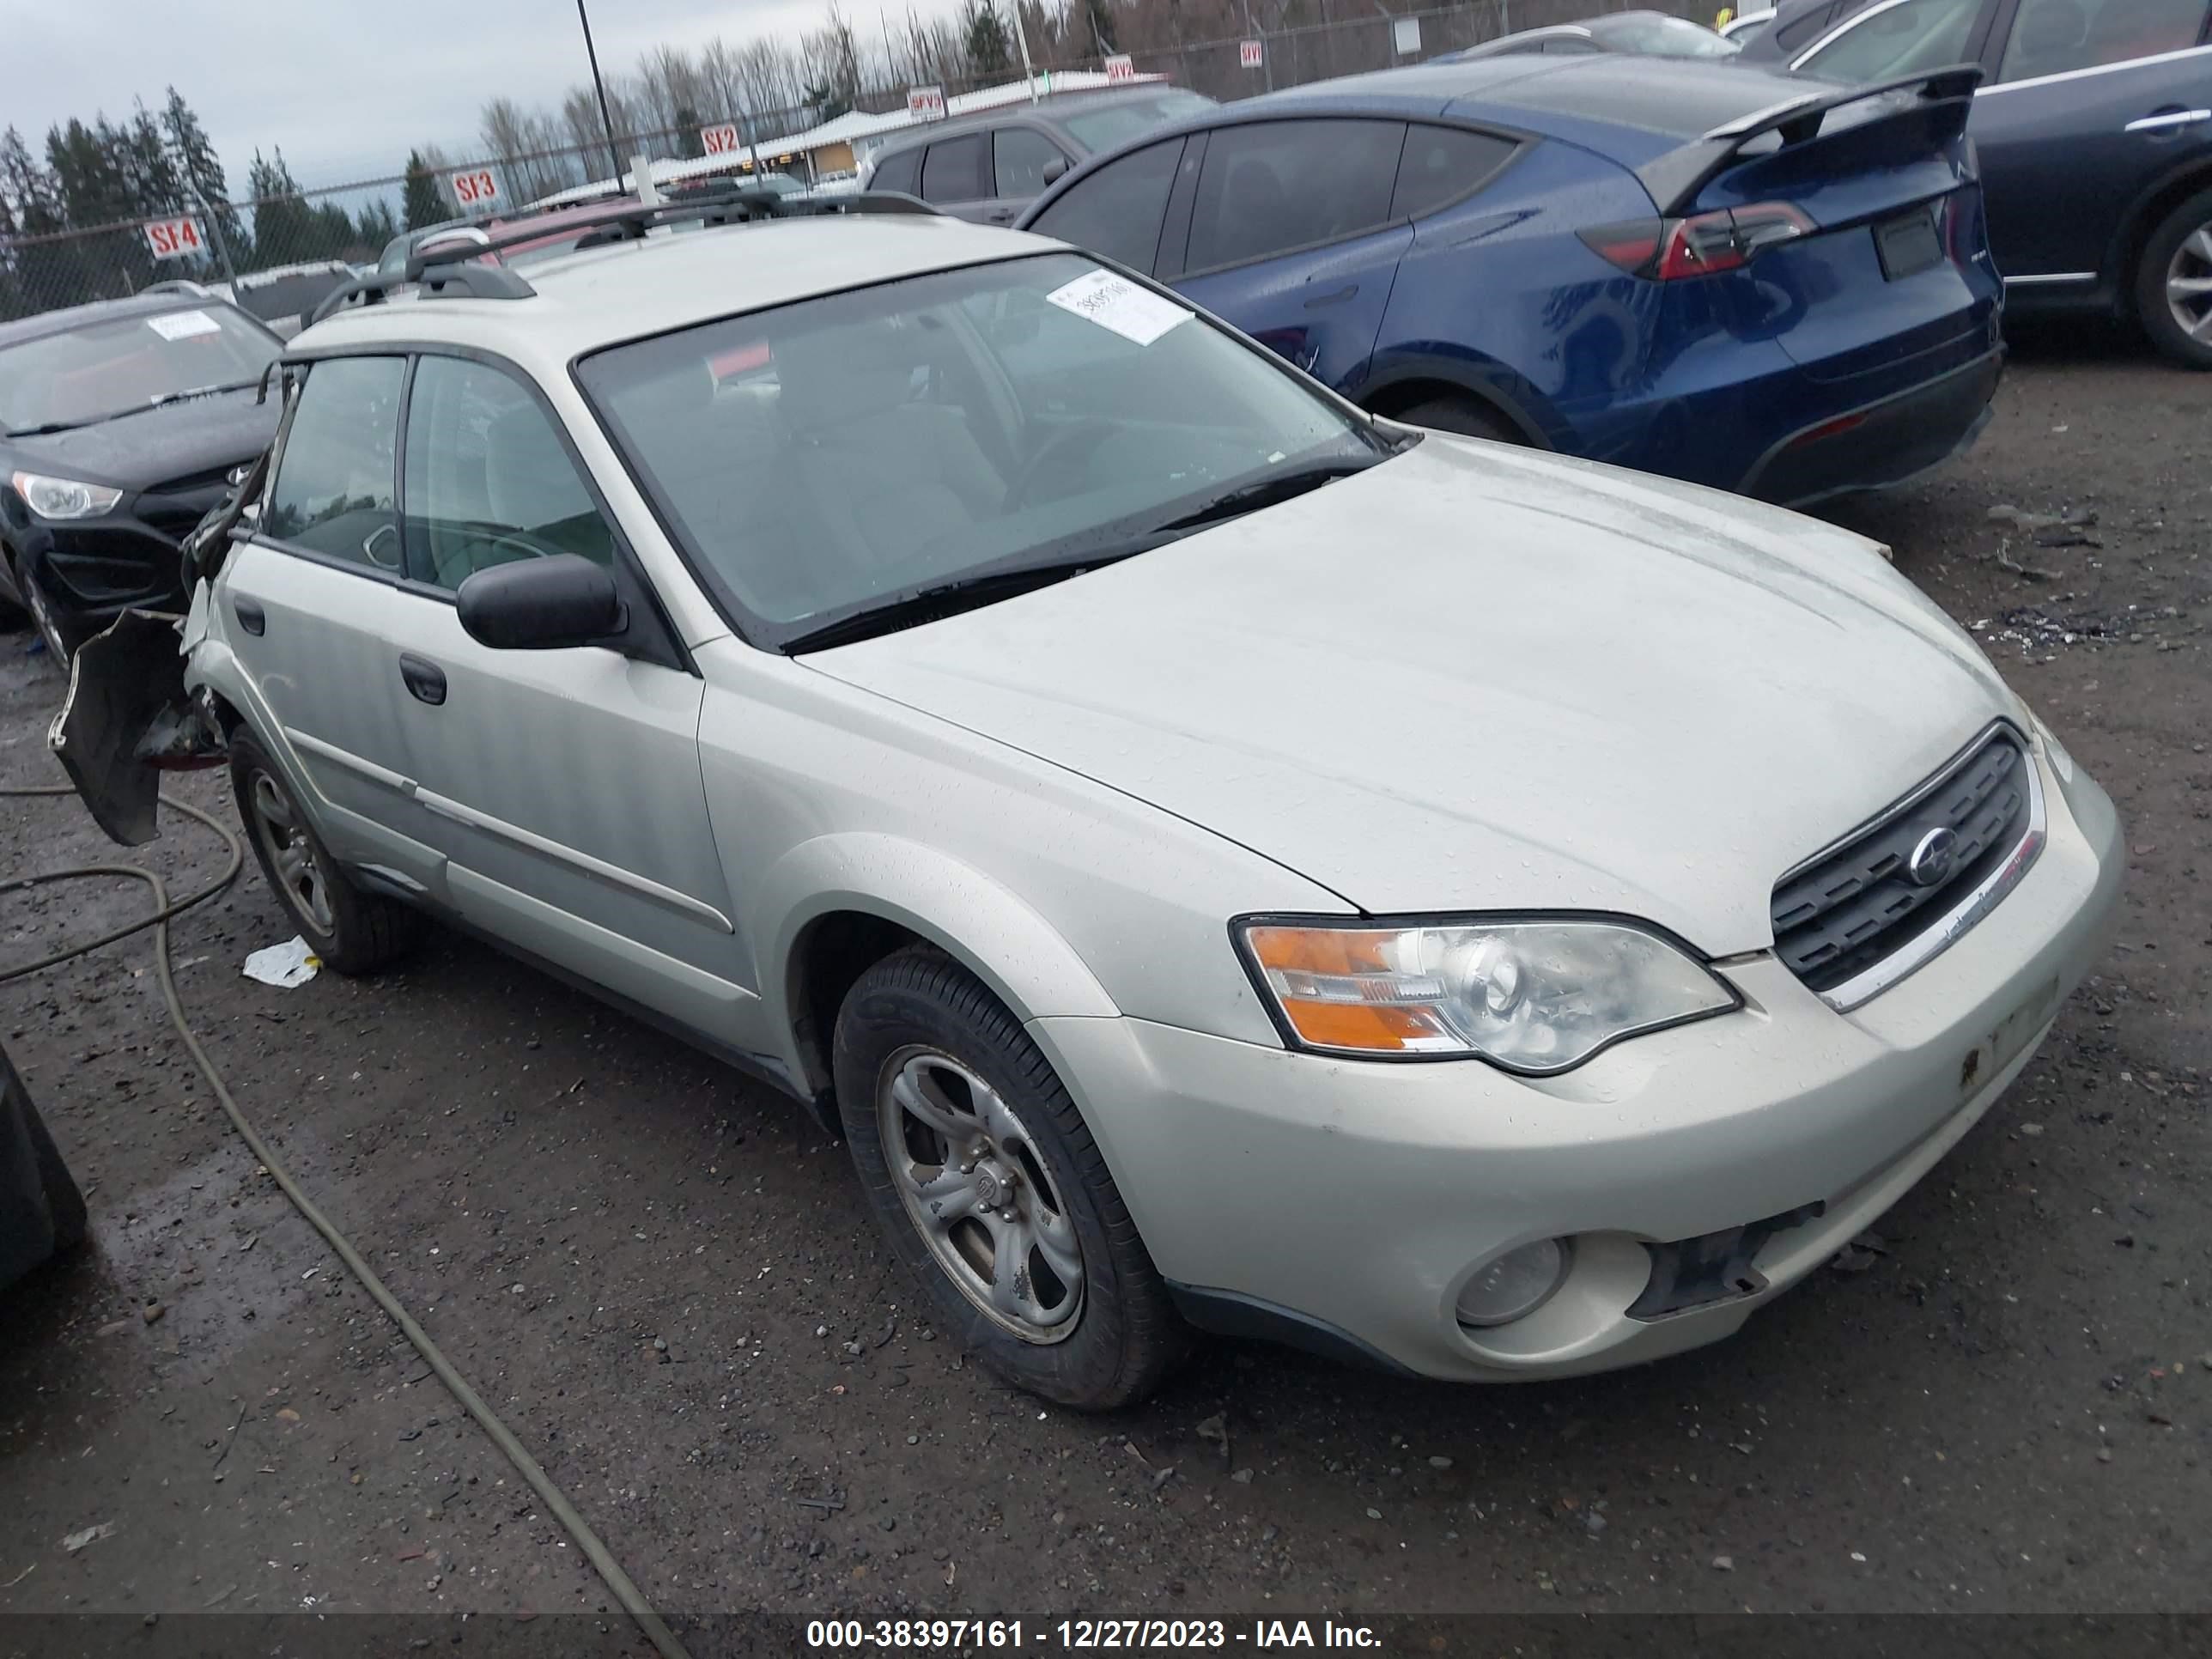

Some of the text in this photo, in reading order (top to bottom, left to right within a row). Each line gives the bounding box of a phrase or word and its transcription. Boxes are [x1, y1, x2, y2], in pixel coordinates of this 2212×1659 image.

[704, 128, 738, 153] SF2
[455, 171, 495, 203] SF3
[151, 220, 198, 253] SF4
